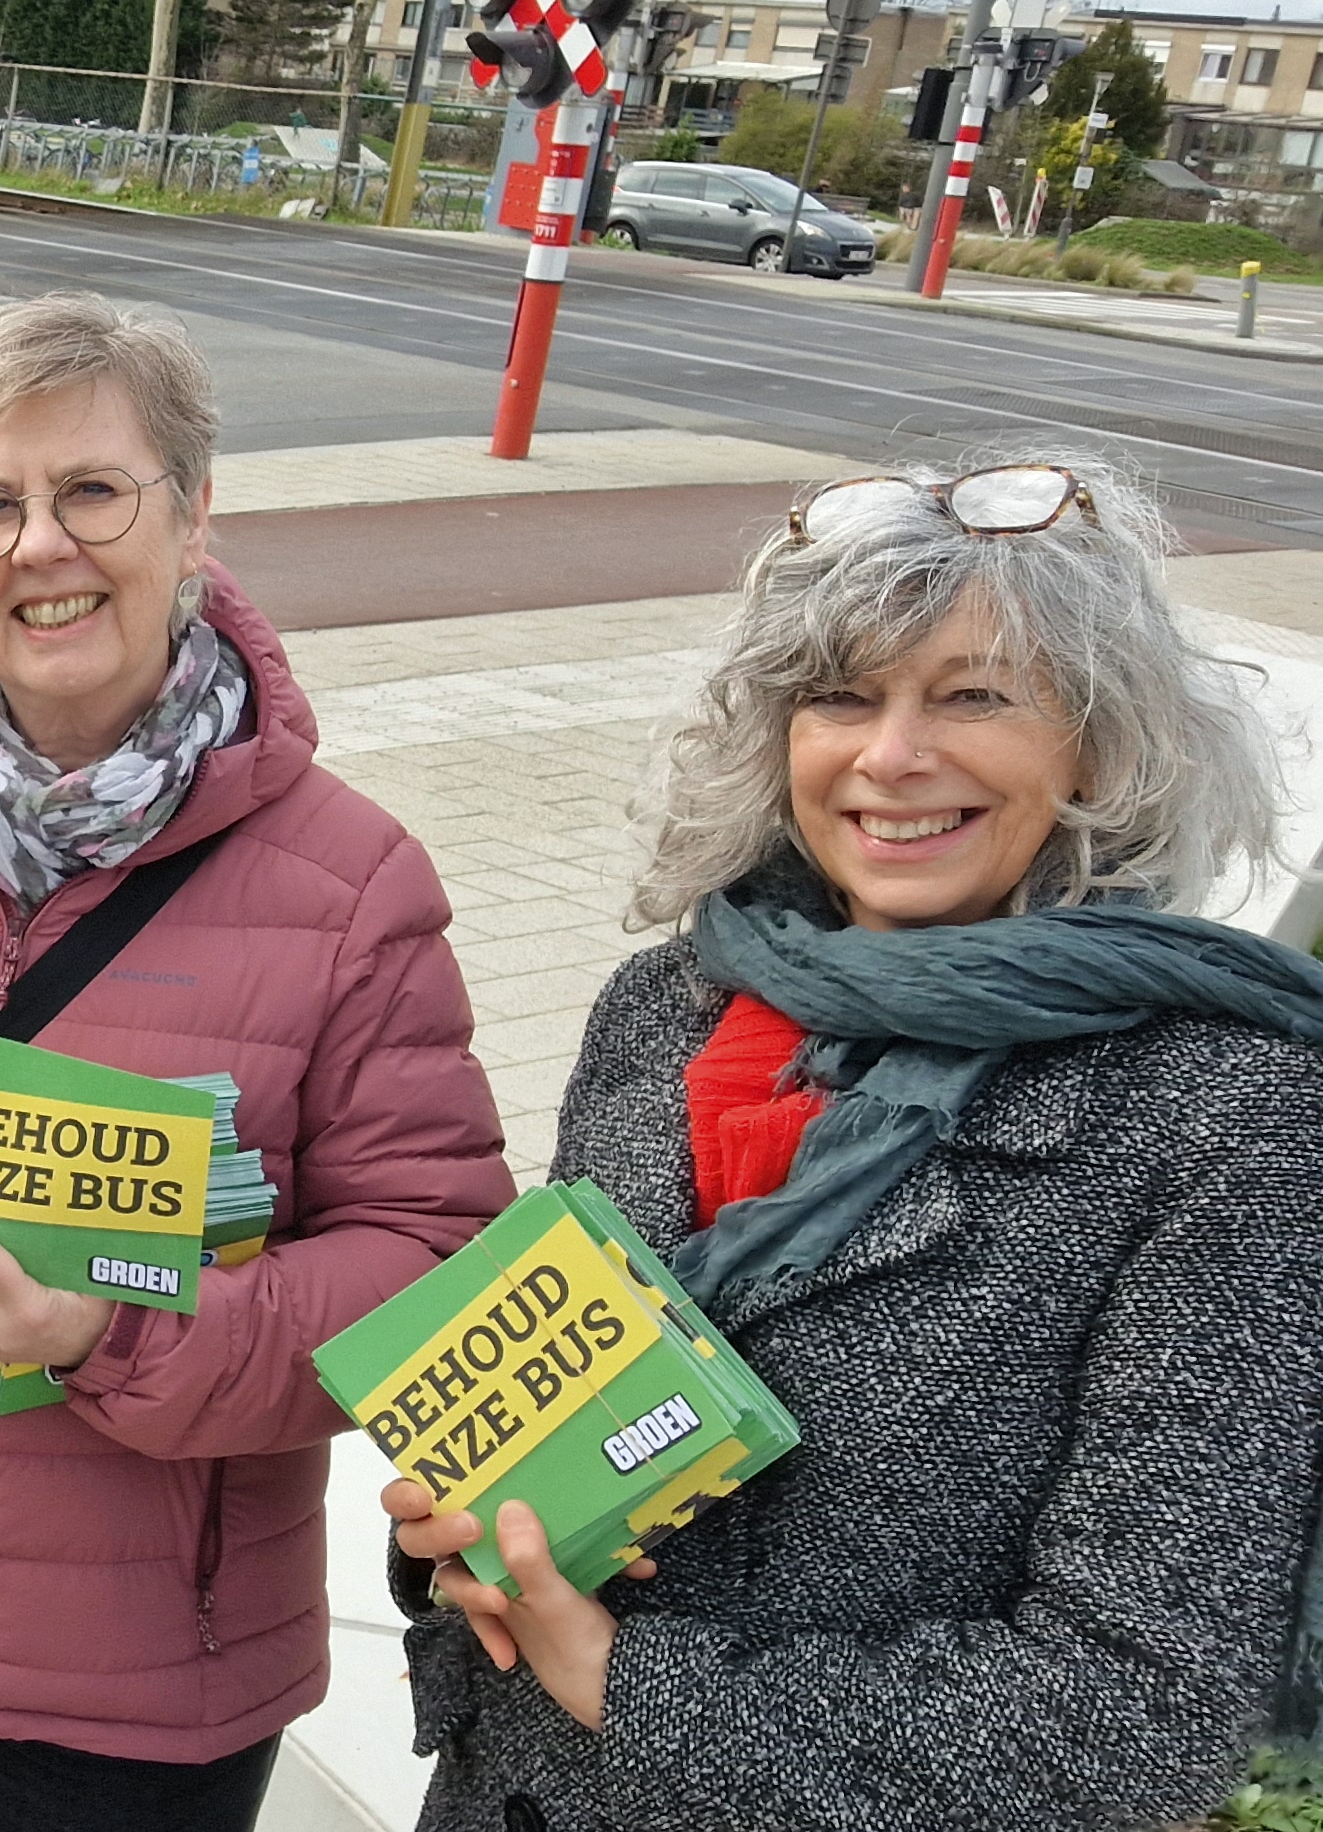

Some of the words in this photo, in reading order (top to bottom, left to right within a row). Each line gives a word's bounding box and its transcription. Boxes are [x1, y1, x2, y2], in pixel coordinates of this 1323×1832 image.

[66, 1170, 183, 1217] BUS
[92, 1258, 180, 1296] GROEN
[367, 1263, 571, 1460] BEHOUD
[405, 1388, 526, 1502] NZE
[513, 1297, 627, 1412] BUS
[604, 1394, 701, 1474] GROEN
